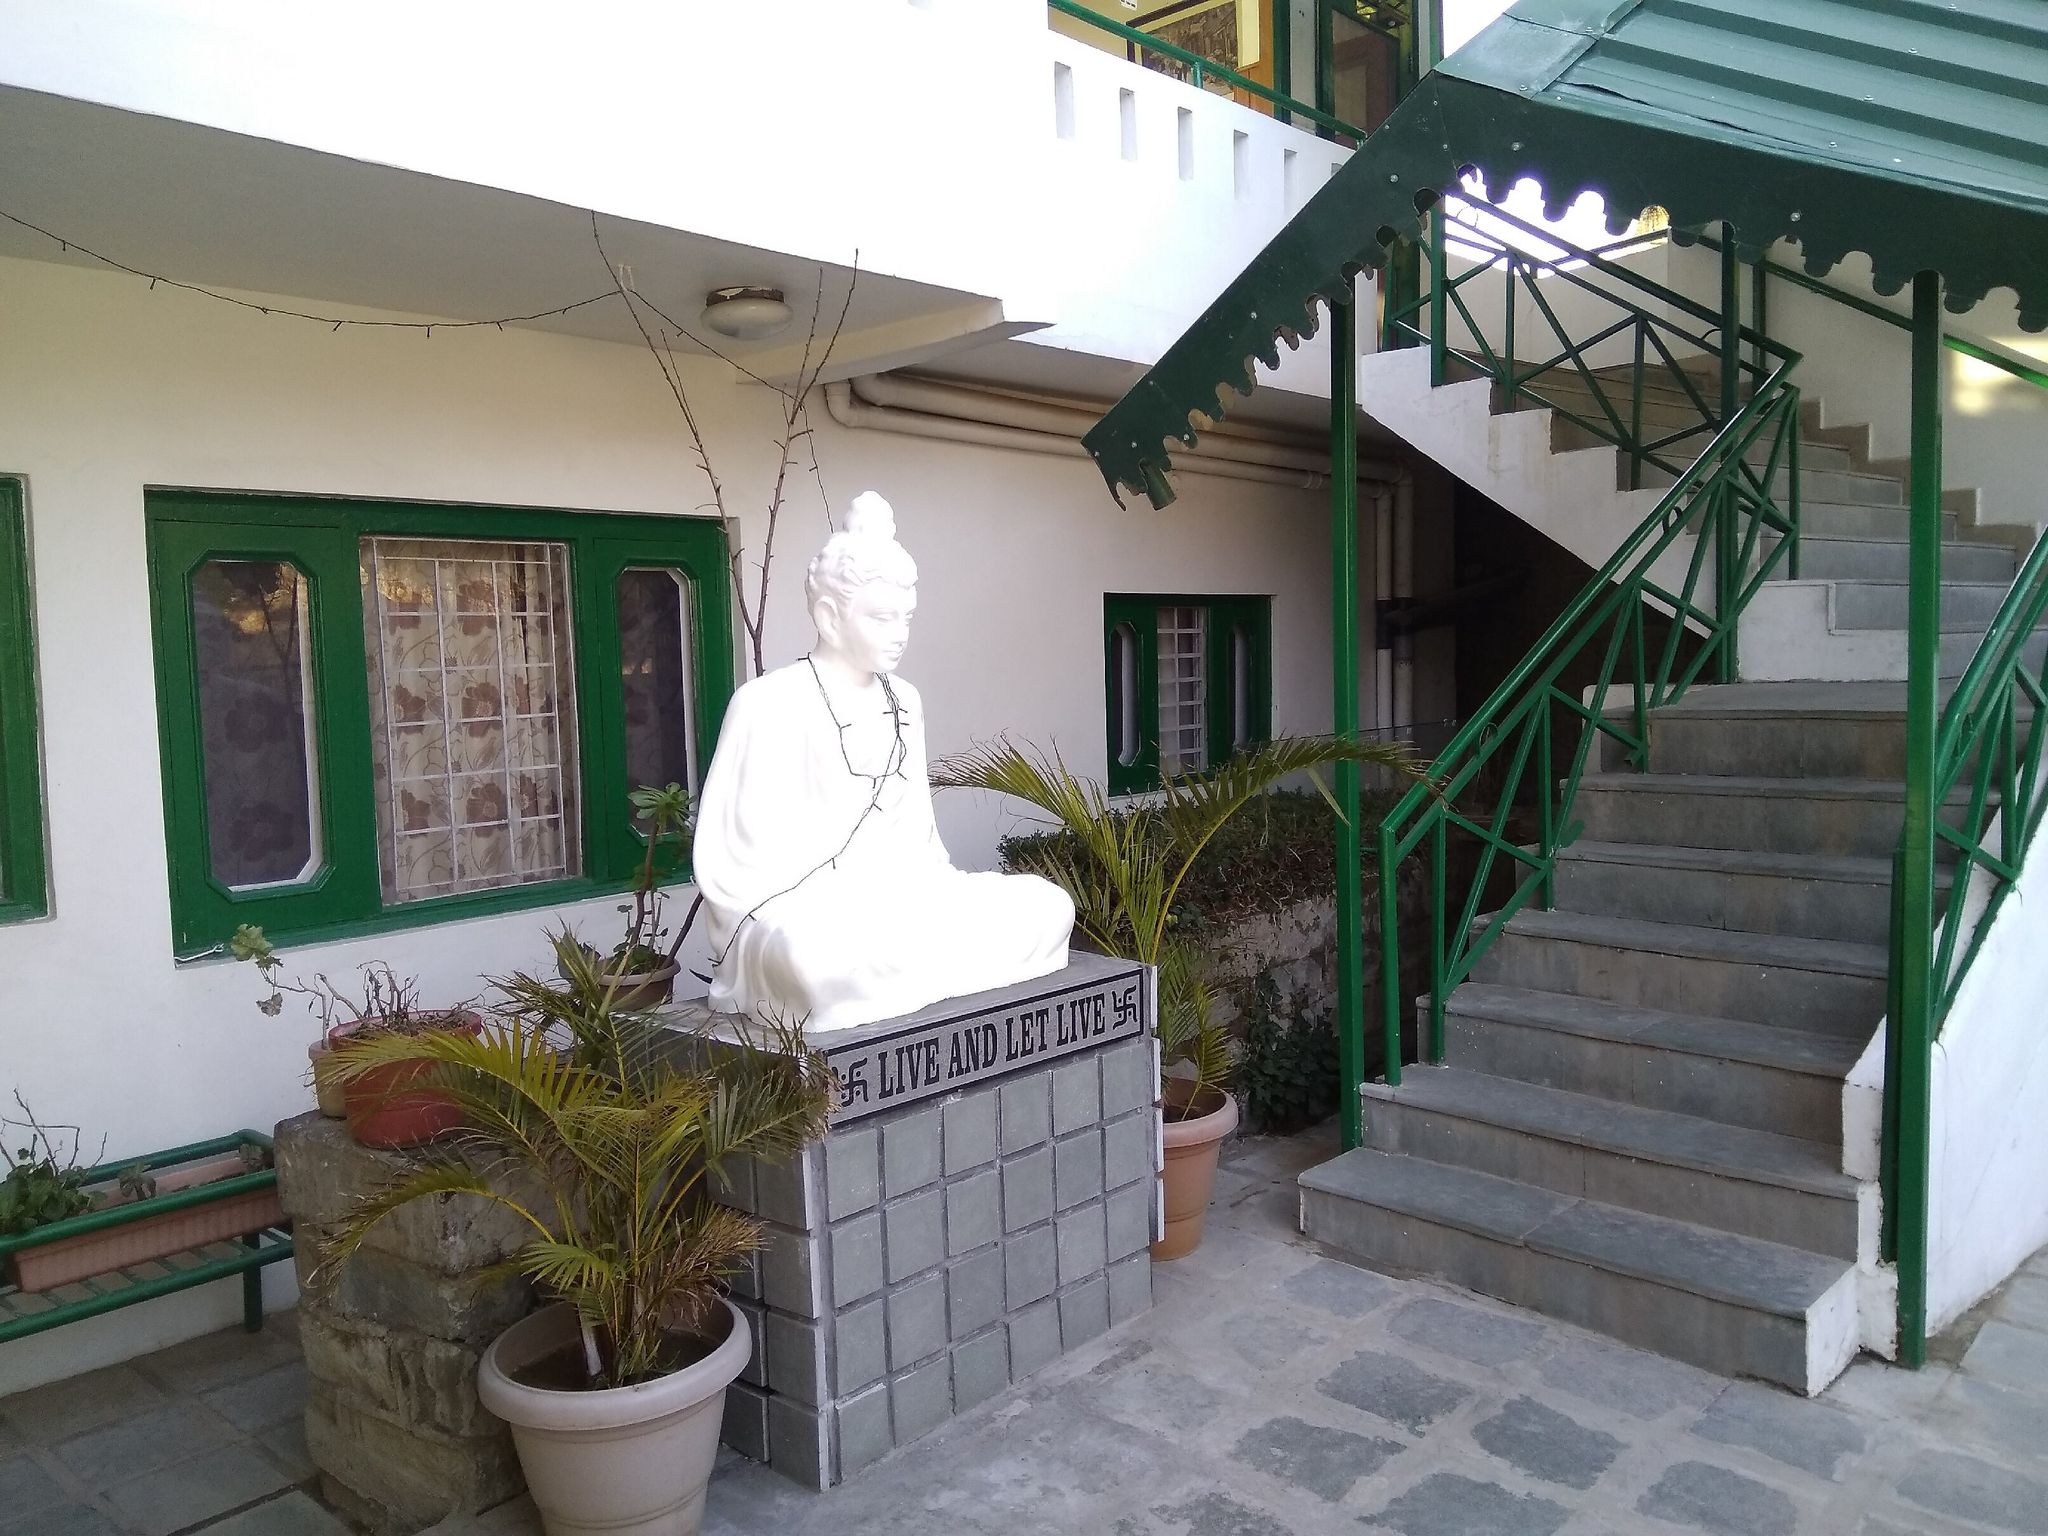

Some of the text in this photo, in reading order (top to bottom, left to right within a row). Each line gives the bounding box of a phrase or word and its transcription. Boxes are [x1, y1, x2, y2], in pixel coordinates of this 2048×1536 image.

[878, 994, 1105, 1099] LIVE AND LET LIVE
